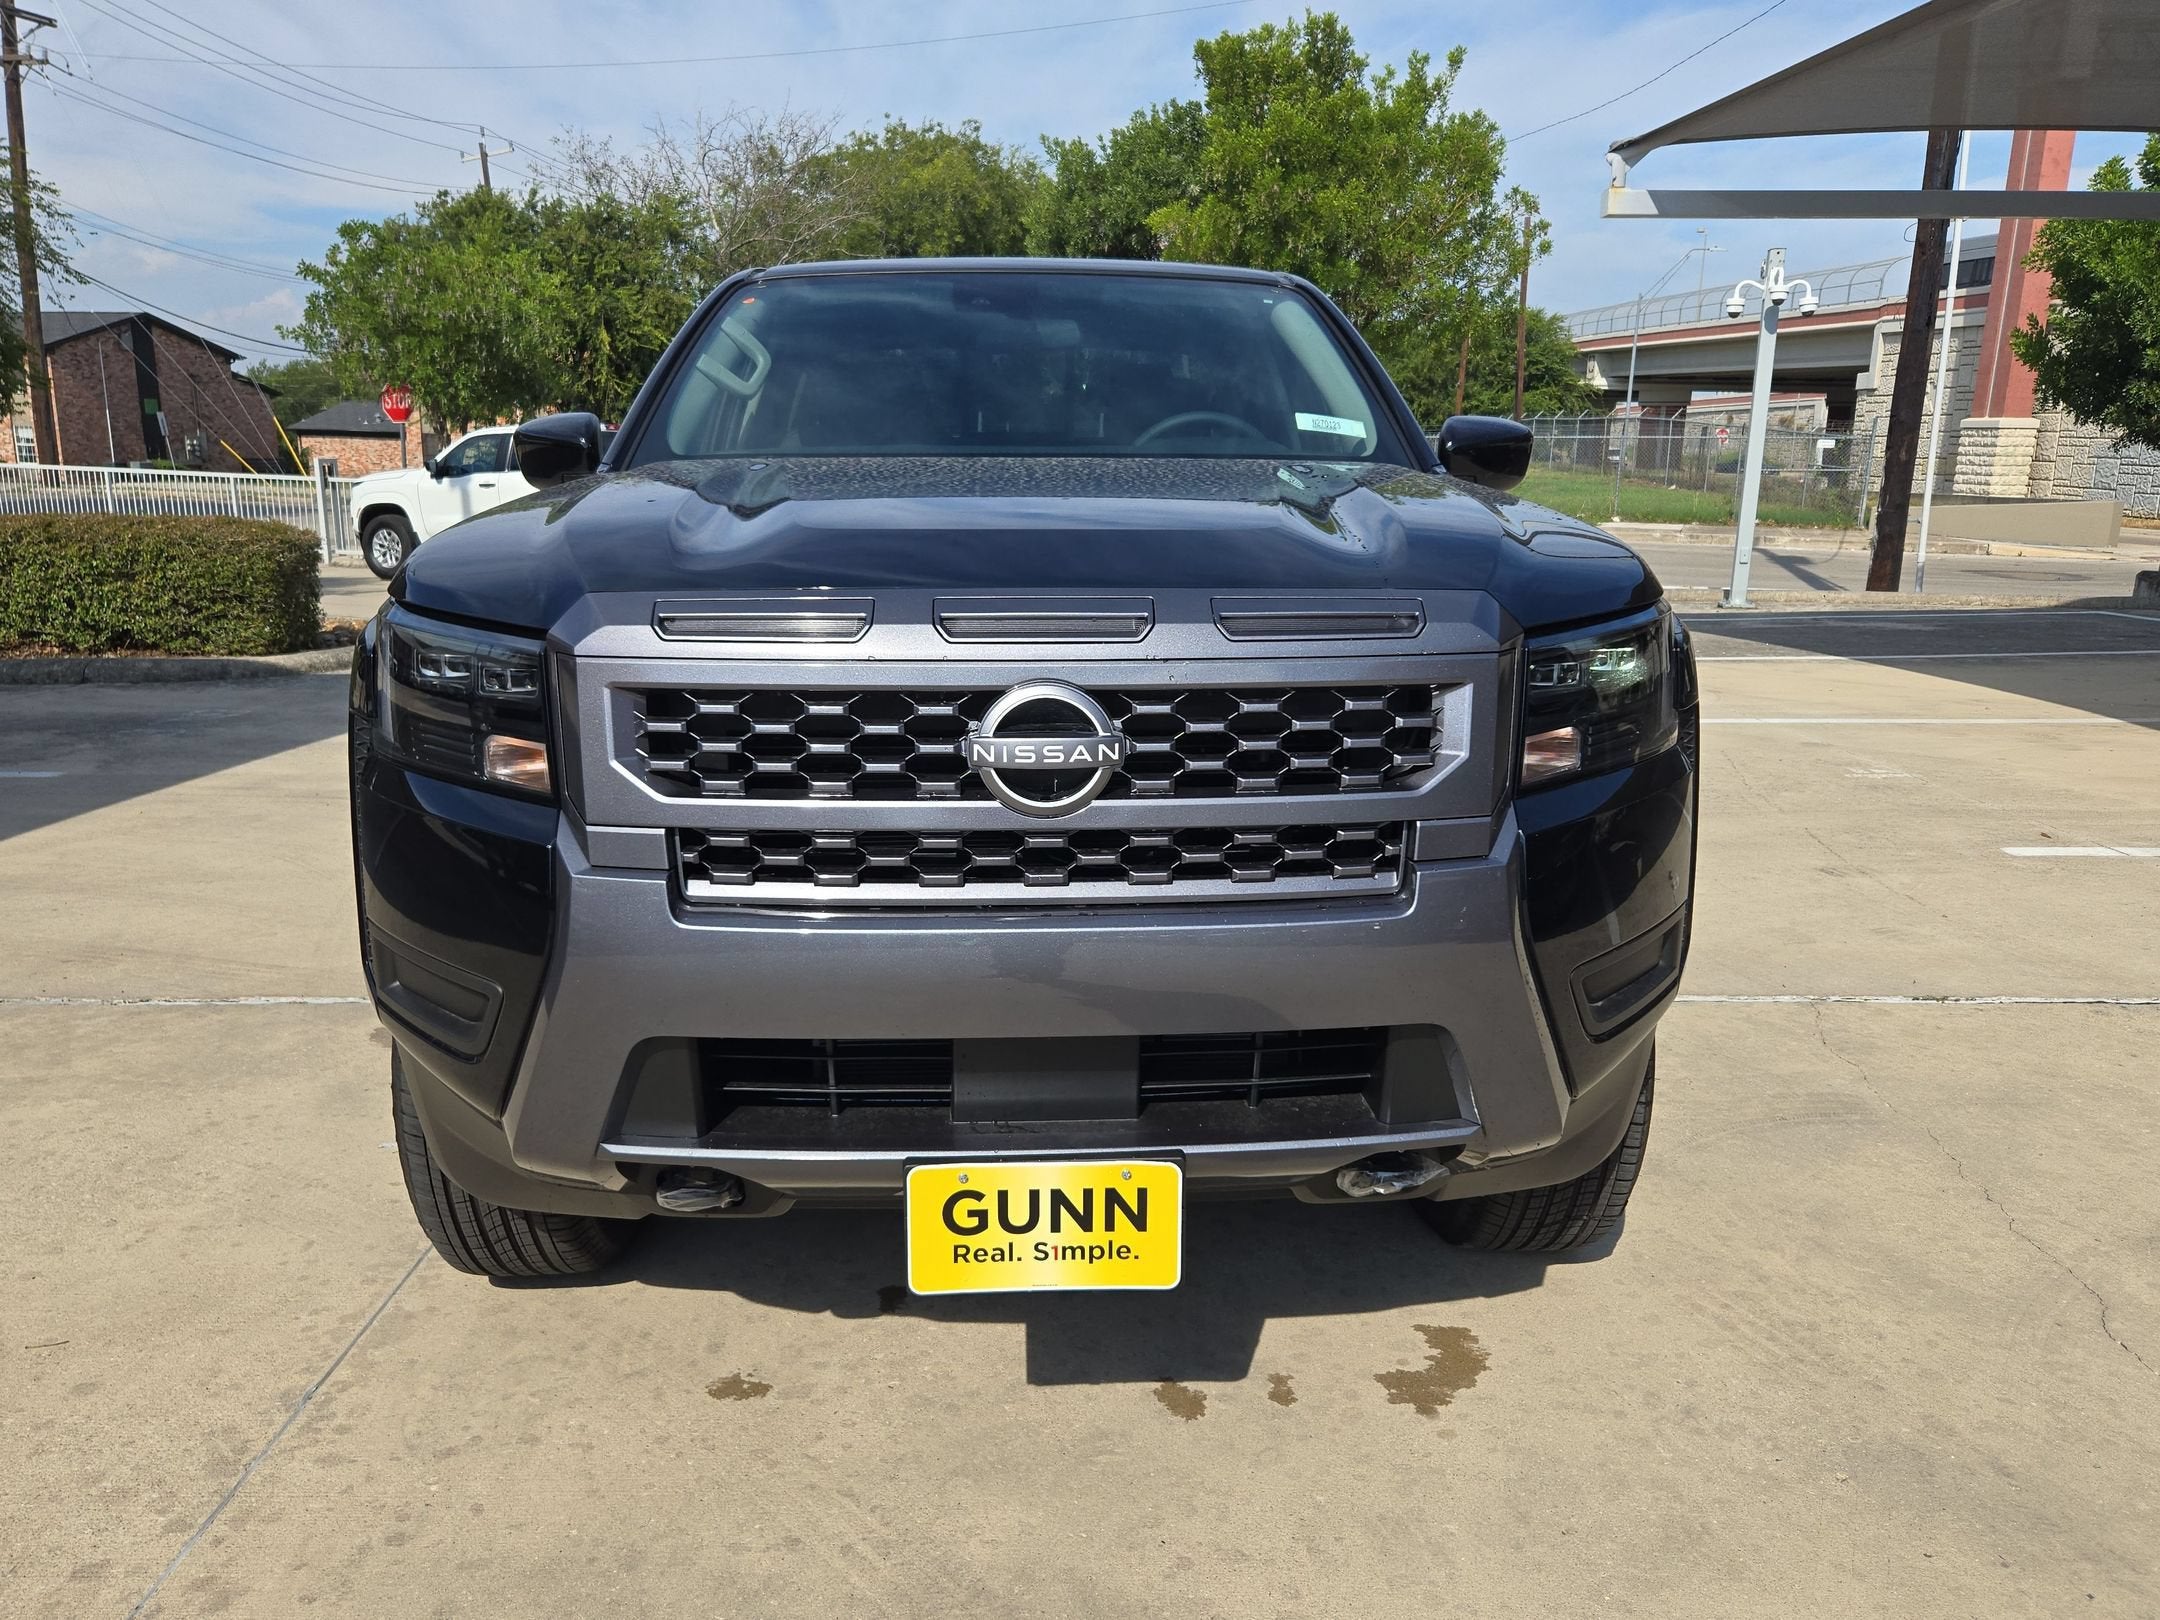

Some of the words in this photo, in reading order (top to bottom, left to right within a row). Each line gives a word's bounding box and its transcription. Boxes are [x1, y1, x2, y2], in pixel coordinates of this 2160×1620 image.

[973, 742, 1119, 763] NISSAN
[942, 1187, 1148, 1236] GUNN
[953, 1242, 1022, 1263] Real.
[1033, 1240, 1139, 1264] S1mple.
